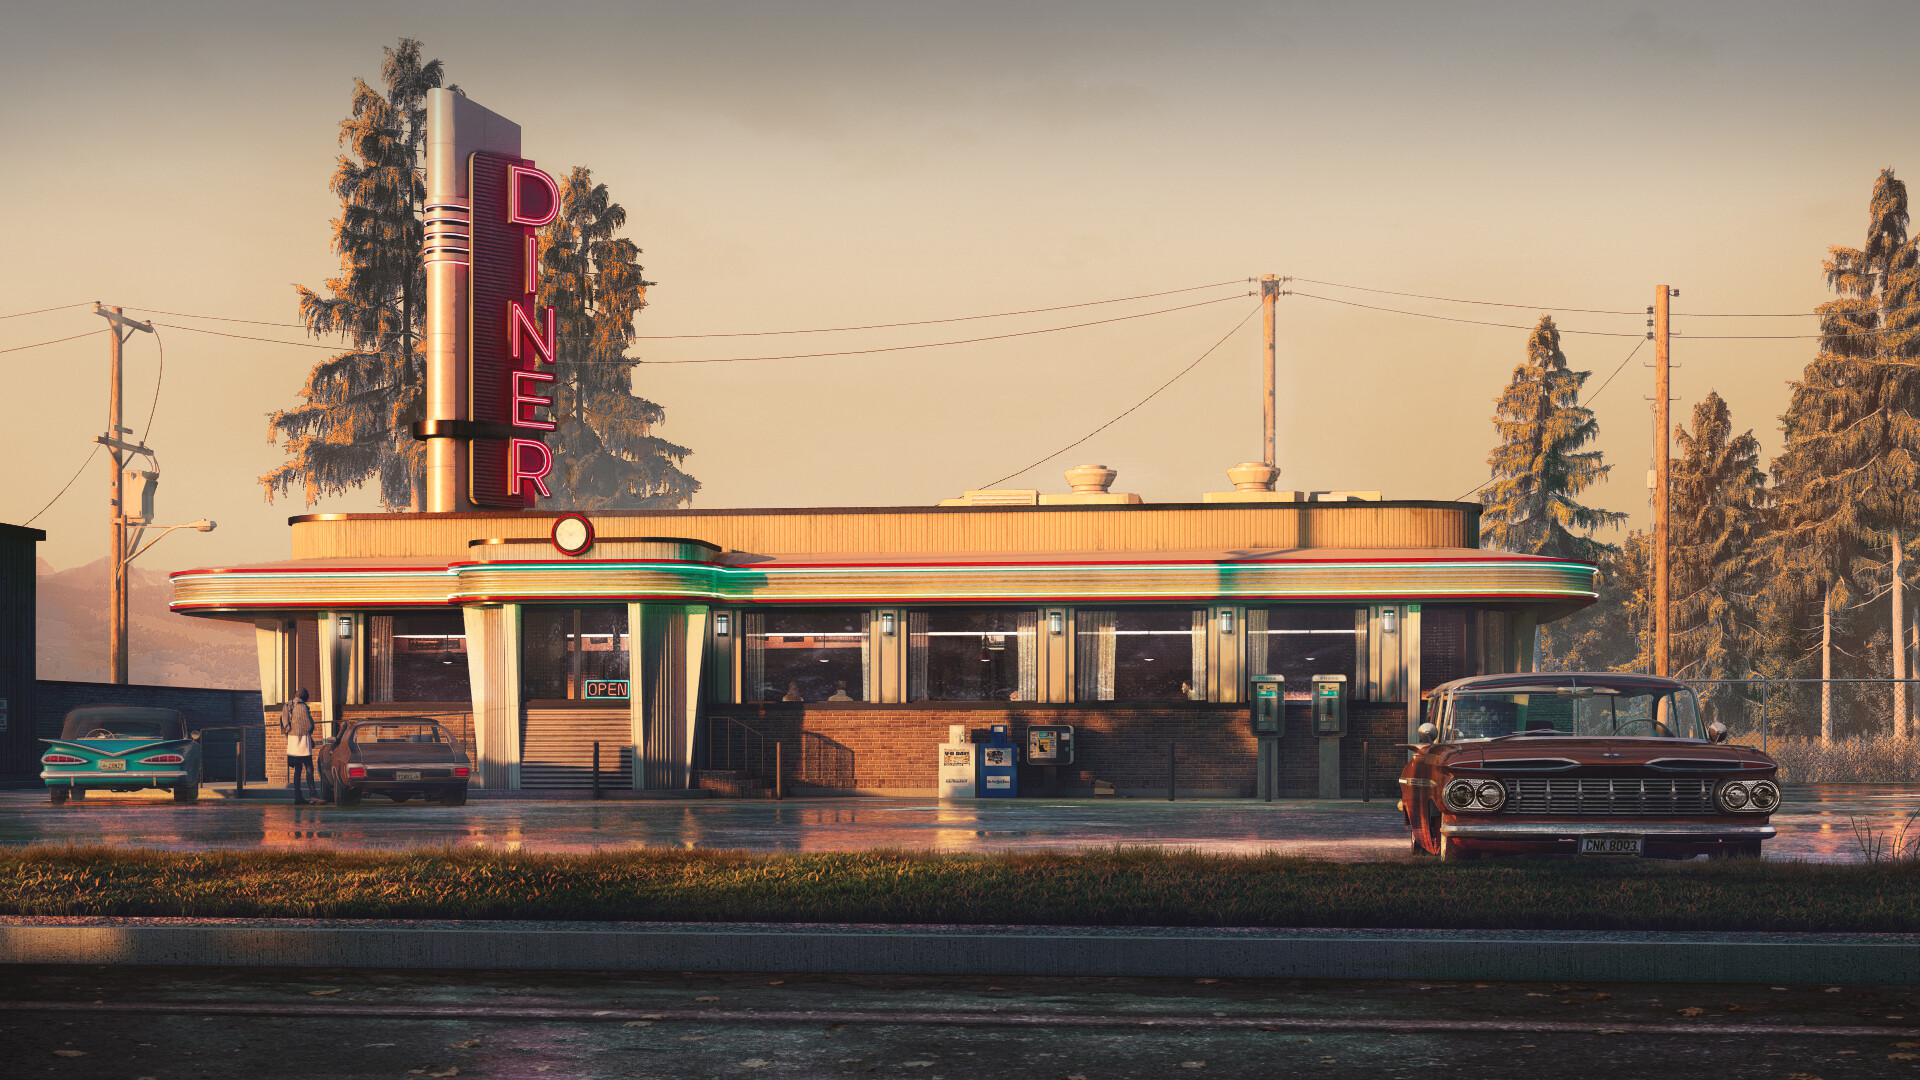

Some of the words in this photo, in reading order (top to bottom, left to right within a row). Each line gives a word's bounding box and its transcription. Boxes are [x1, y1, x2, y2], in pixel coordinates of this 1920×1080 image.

[509, 163, 560, 498] DINER
[588, 682, 627, 696] OPEN
[1586, 840, 1606, 851] CNK
